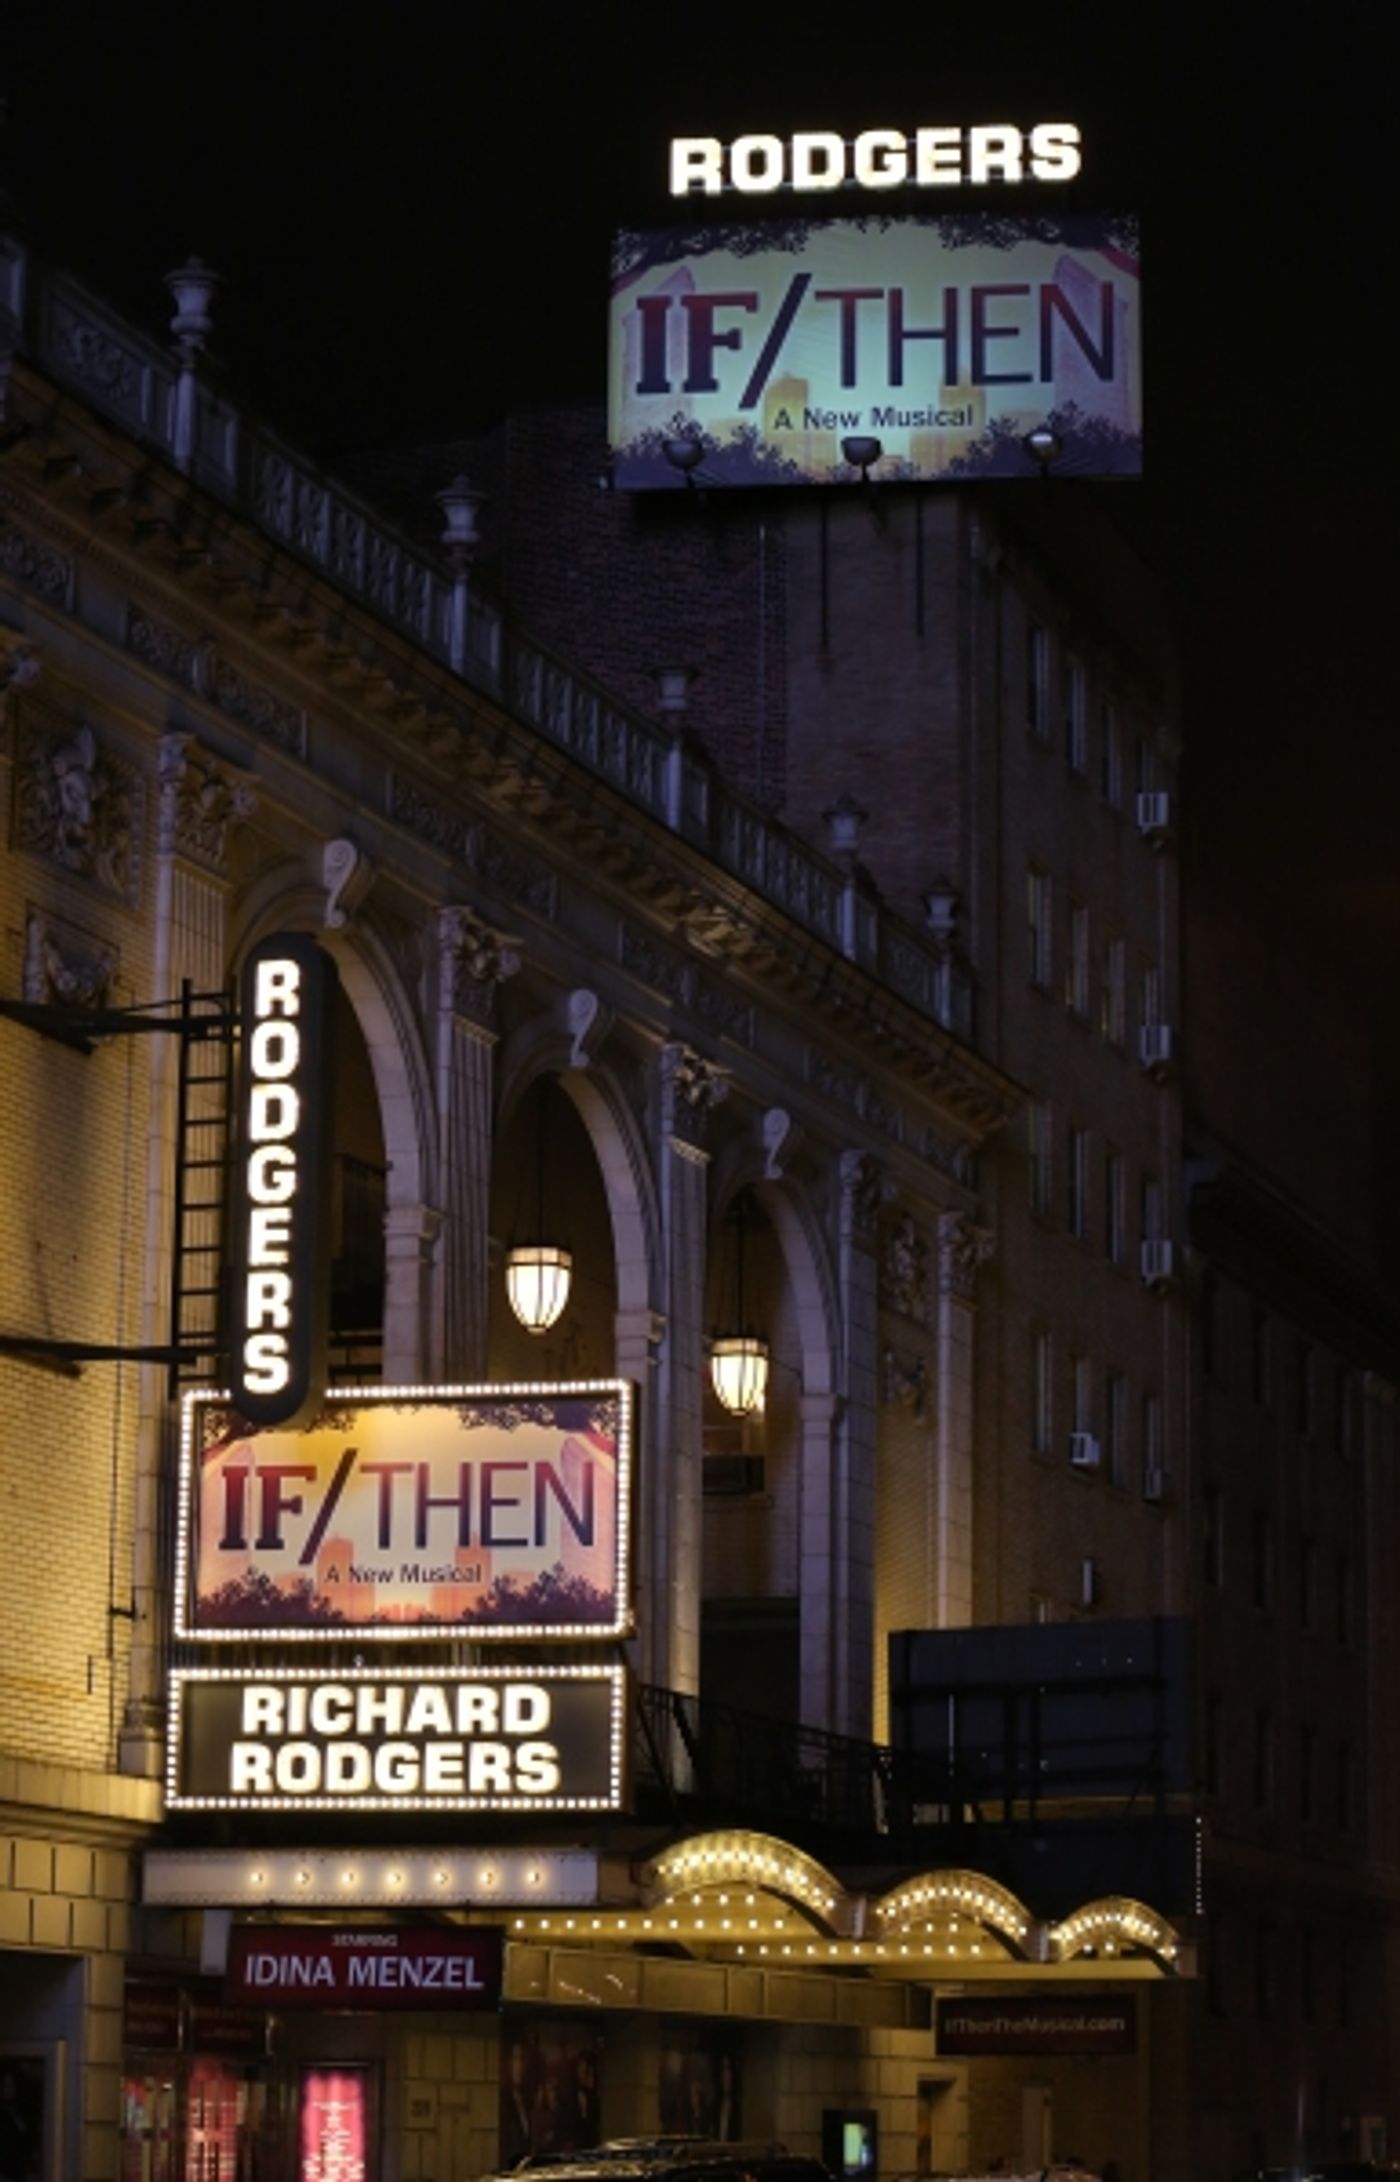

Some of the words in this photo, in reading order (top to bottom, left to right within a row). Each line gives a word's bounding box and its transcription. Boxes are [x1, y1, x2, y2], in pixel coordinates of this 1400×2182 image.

[670, 123, 1082, 196] RODGERS
[636, 272, 1114, 410] IF/THEN
[773, 410, 794, 431] A
[802, 408, 862, 430] New
[870, 404, 974, 429] Musical
[243, 959, 300, 1394] RODGERS
[218, 1448, 595, 1566] IF/THEN
[325, 1567, 340, 1584] A
[348, 1565, 394, 1584] New
[401, 1563, 482, 1583] Musical
[242, 1685, 551, 1736] RICHARD
[230, 1741, 561, 1794] RODGERS
[244, 1954, 336, 1987] IDINA
[347, 1956, 485, 1989] MENZEL
